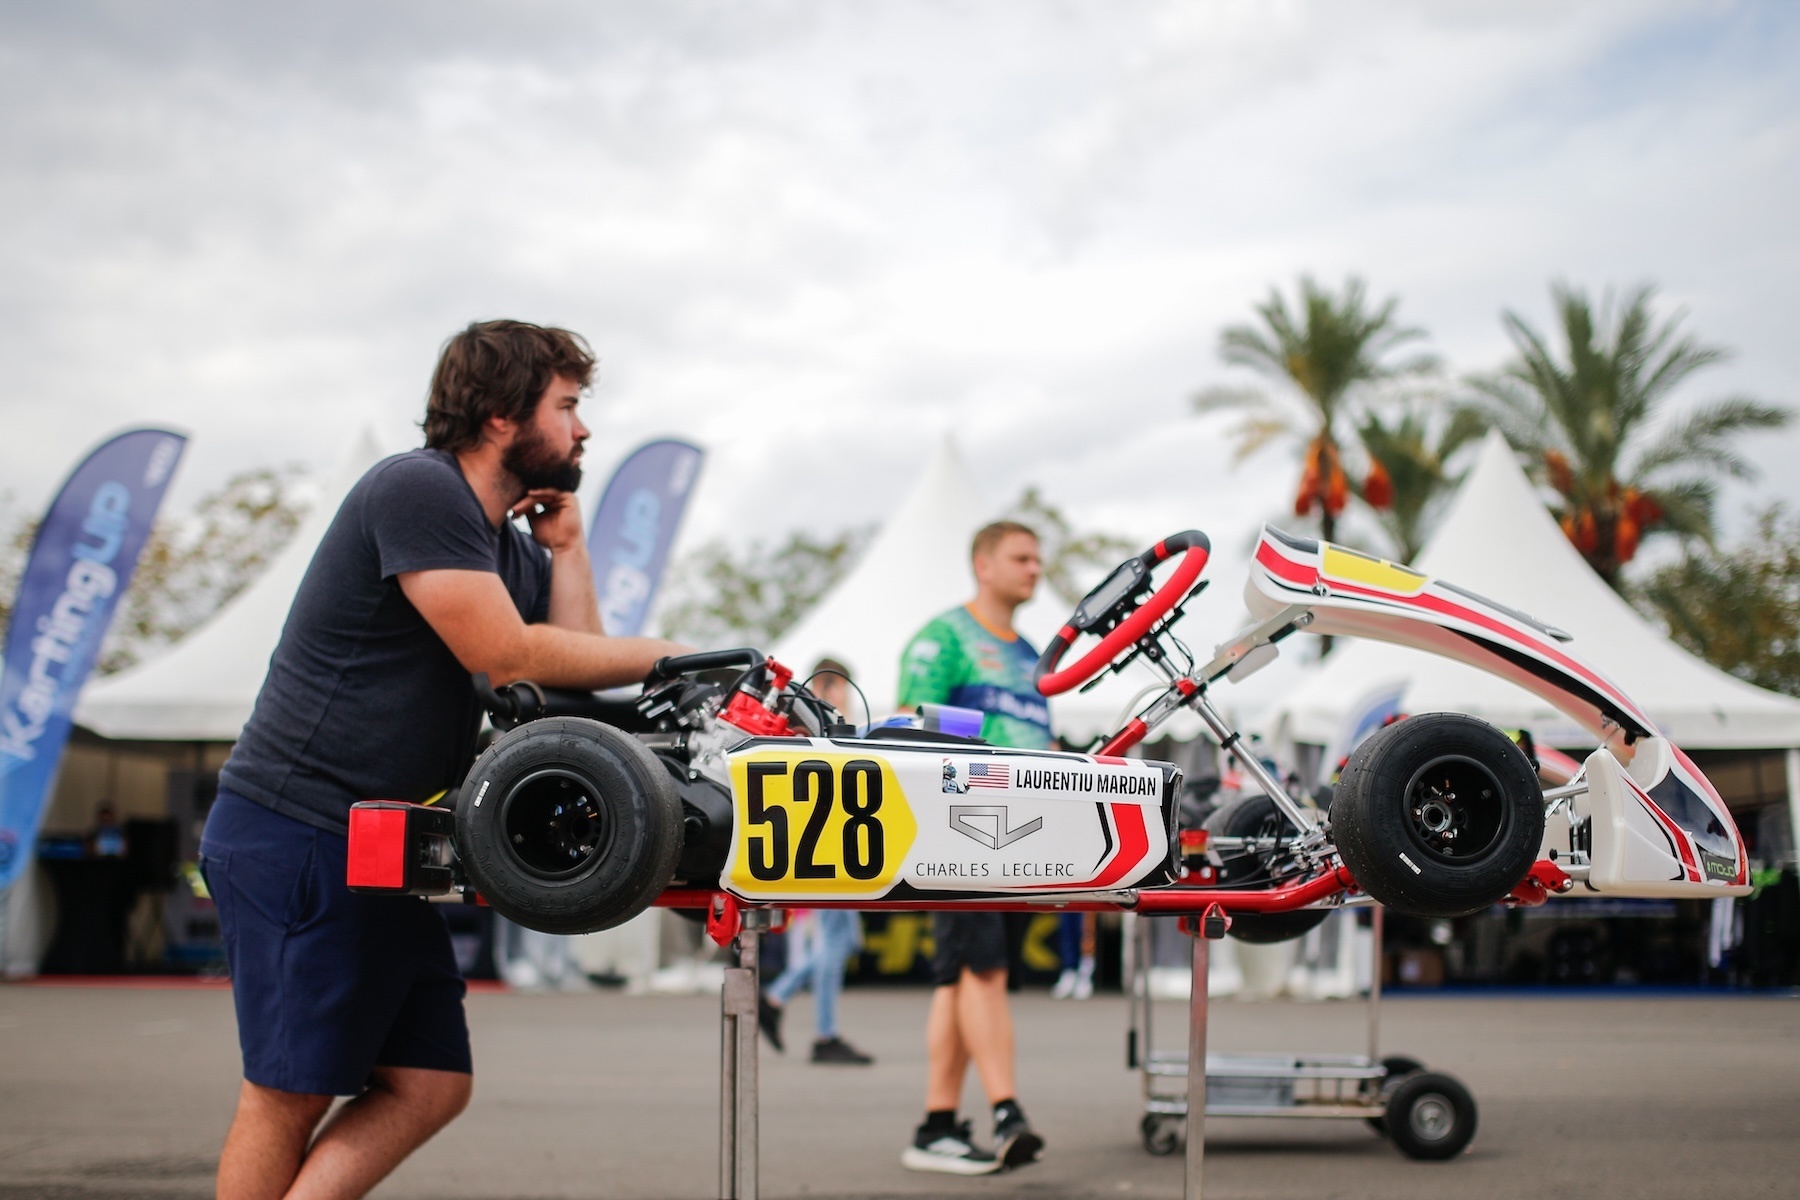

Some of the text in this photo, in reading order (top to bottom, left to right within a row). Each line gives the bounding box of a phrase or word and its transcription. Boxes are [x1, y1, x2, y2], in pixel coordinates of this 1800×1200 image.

[1015, 768, 1157, 797] LAURENTIU MARDAN
[747, 760, 884, 881] 528
[915, 862, 1075, 877] CHARLES LECLERC
